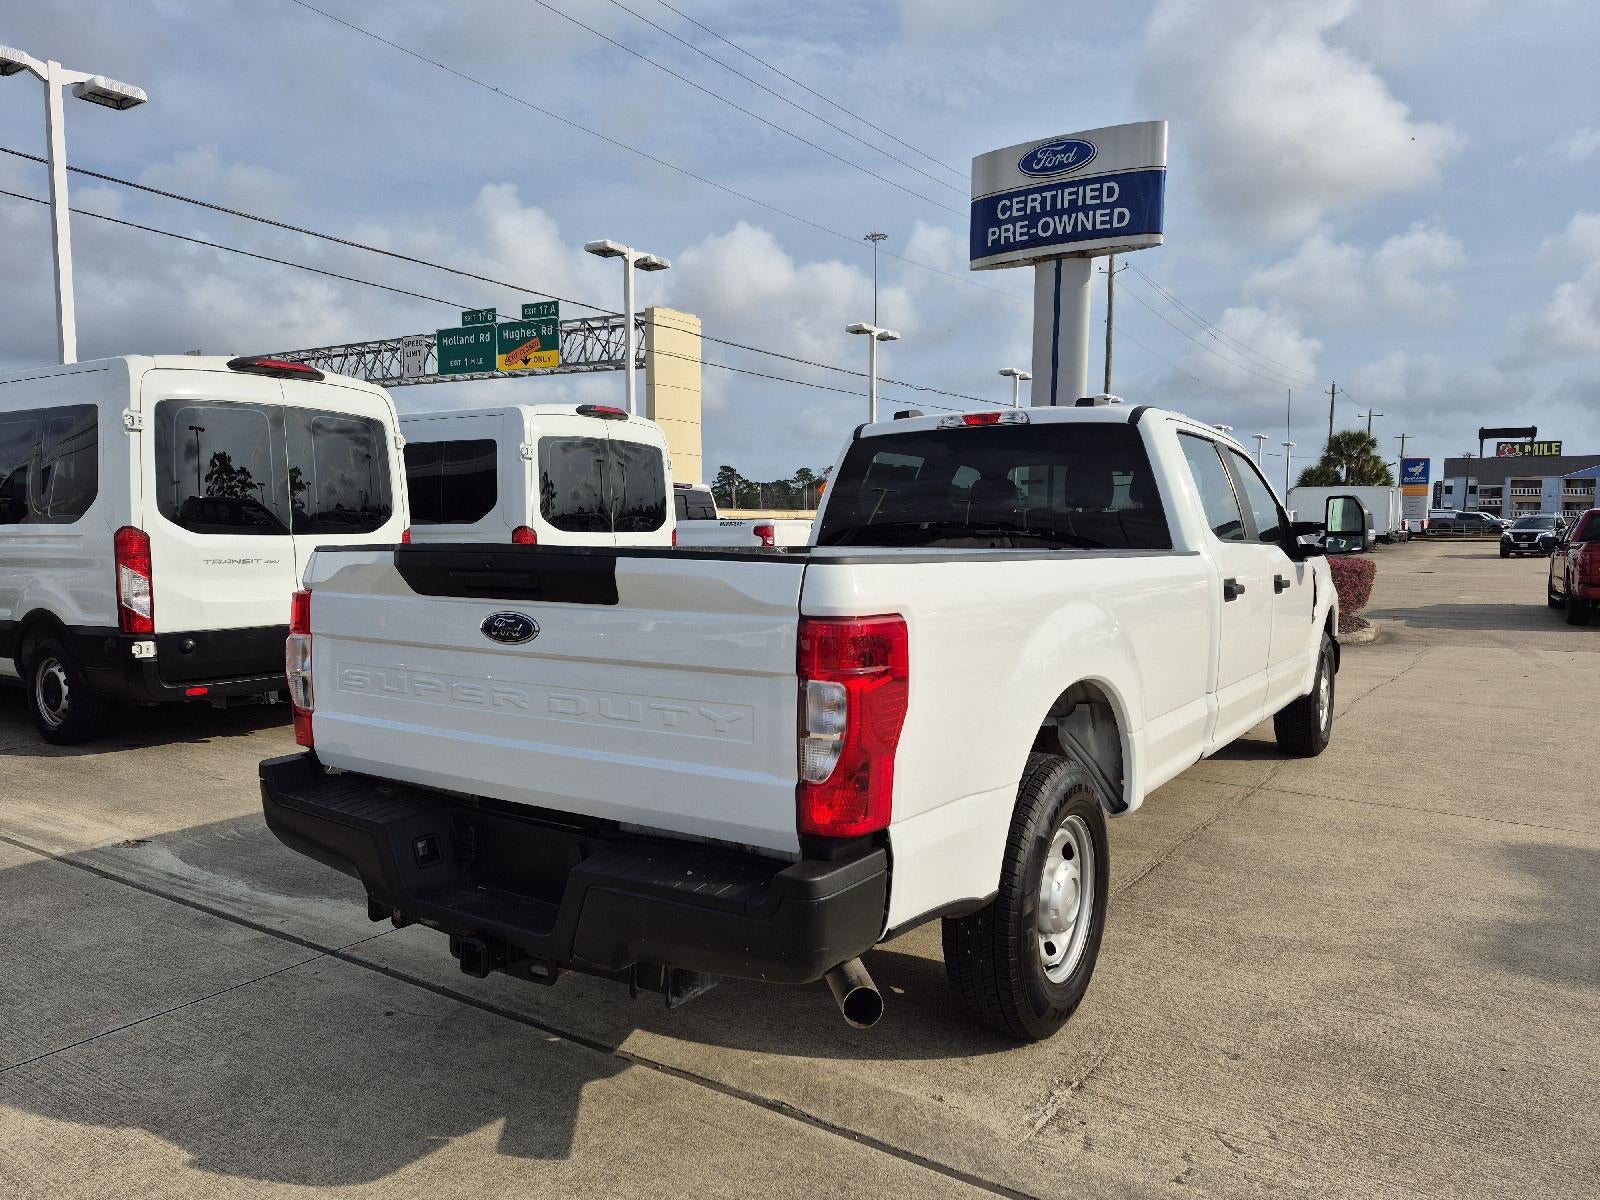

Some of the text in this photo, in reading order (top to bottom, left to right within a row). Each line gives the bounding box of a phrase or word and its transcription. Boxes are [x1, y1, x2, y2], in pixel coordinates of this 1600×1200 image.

[1033, 144, 1078, 170] Ford
[997, 181, 1120, 220] CERTIFIED
[987, 207, 1131, 247] PRE-OWNED
[524, 307, 537, 315] EXIT
[442, 332, 491, 347] Holland Rd
[502, 325, 553, 341] Hughes Rd
[406, 349, 421, 358] LIMIT
[533, 355, 552, 364] ONLY
[449, 359, 461, 367] EXIT
[491, 617, 523, 637] Ford
[341, 668, 746, 733] SUPER DUTY
